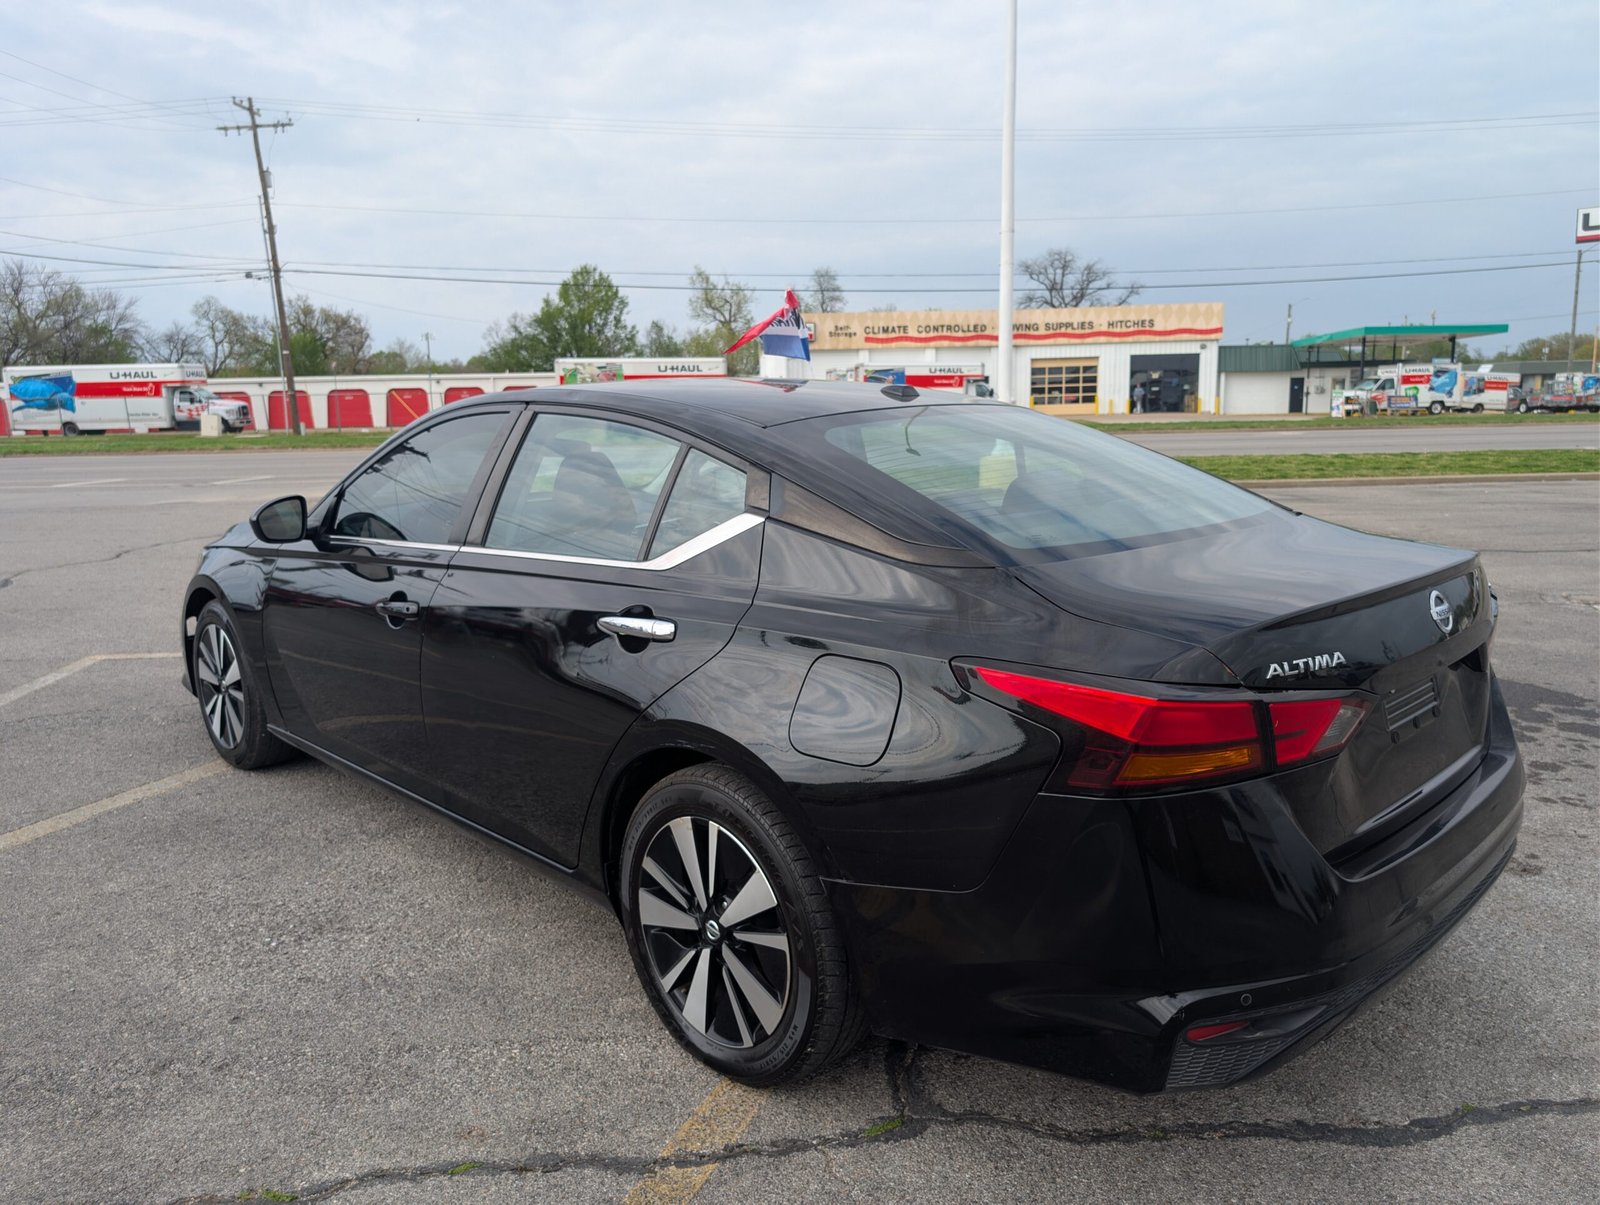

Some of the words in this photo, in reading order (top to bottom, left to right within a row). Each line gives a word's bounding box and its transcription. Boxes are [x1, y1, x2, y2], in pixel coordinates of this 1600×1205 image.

[864, 325, 909, 335] CLIMATE
[917, 324, 987, 334] CONTROLLED
[1044, 321, 1094, 331] SUPPLIES
[1107, 319, 1155, 330] HITCHES
[658, 364, 703, 373] U-HAUL
[109, 371, 158, 379] U-HAUL
[185, 370, 206, 378] U-HAUL
[1266, 651, 1347, 679] ALTIMA
